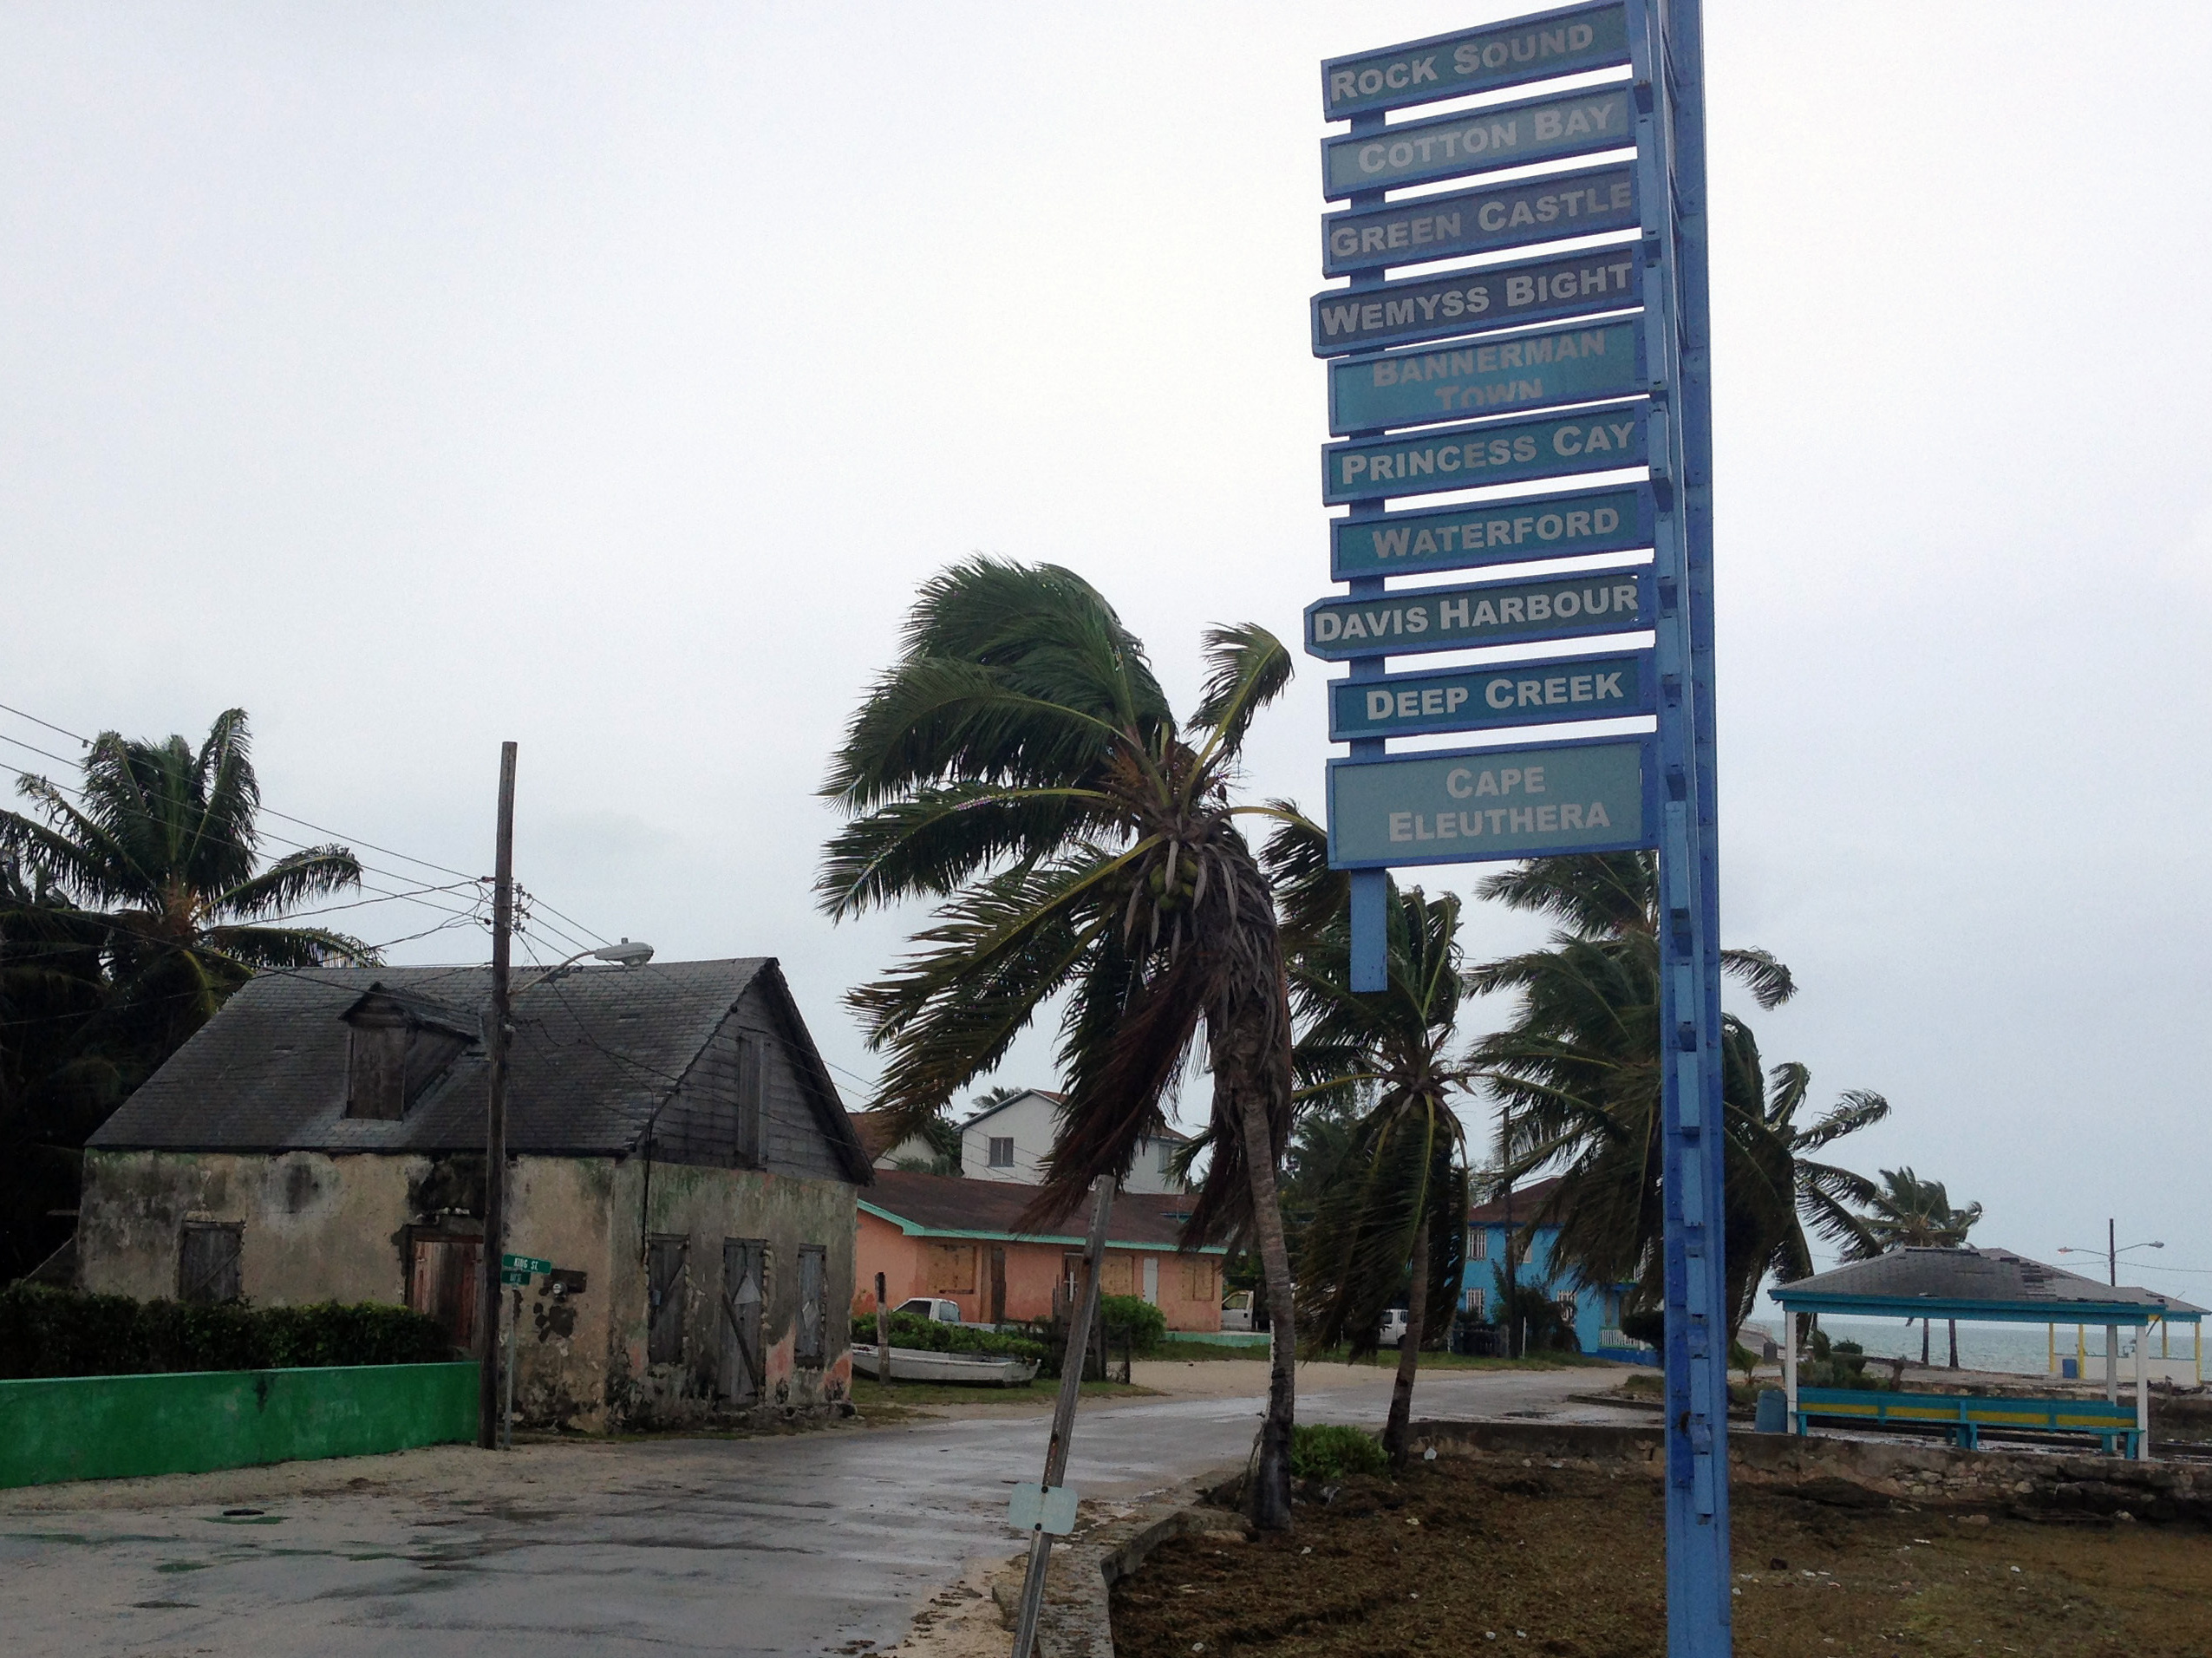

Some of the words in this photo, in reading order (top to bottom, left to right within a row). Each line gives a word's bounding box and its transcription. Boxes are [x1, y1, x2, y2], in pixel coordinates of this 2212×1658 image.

[1330, 55, 1439, 101] ROCK
[1453, 23, 1594, 75] SOUND
[1358, 122, 1517, 173] COTTON
[1534, 103, 1614, 140] BAY
[1330, 212, 1461, 257] GREEN
[1478, 182, 1632, 232] CASTLE
[1321, 291, 1490, 336] WEMYSS
[1507, 263, 1632, 307] BIGHT
[1373, 330, 1606, 387] BANNERMAN
[1435, 378, 1543, 410] TOWN
[1341, 435, 1537, 484] PRINCESS
[1553, 421, 1635, 457] CAY
[1372, 508, 1619, 558] WATERFORD
[1315, 606, 1429, 643] DAVIS
[1439, 584, 1638, 630] HARBOUR
[1367, 687, 1468, 720] DEEP
[1484, 672, 1624, 709] CREEK
[1445, 766, 1545, 799] CAPE
[1389, 802, 1610, 842] ELEUTHERA
